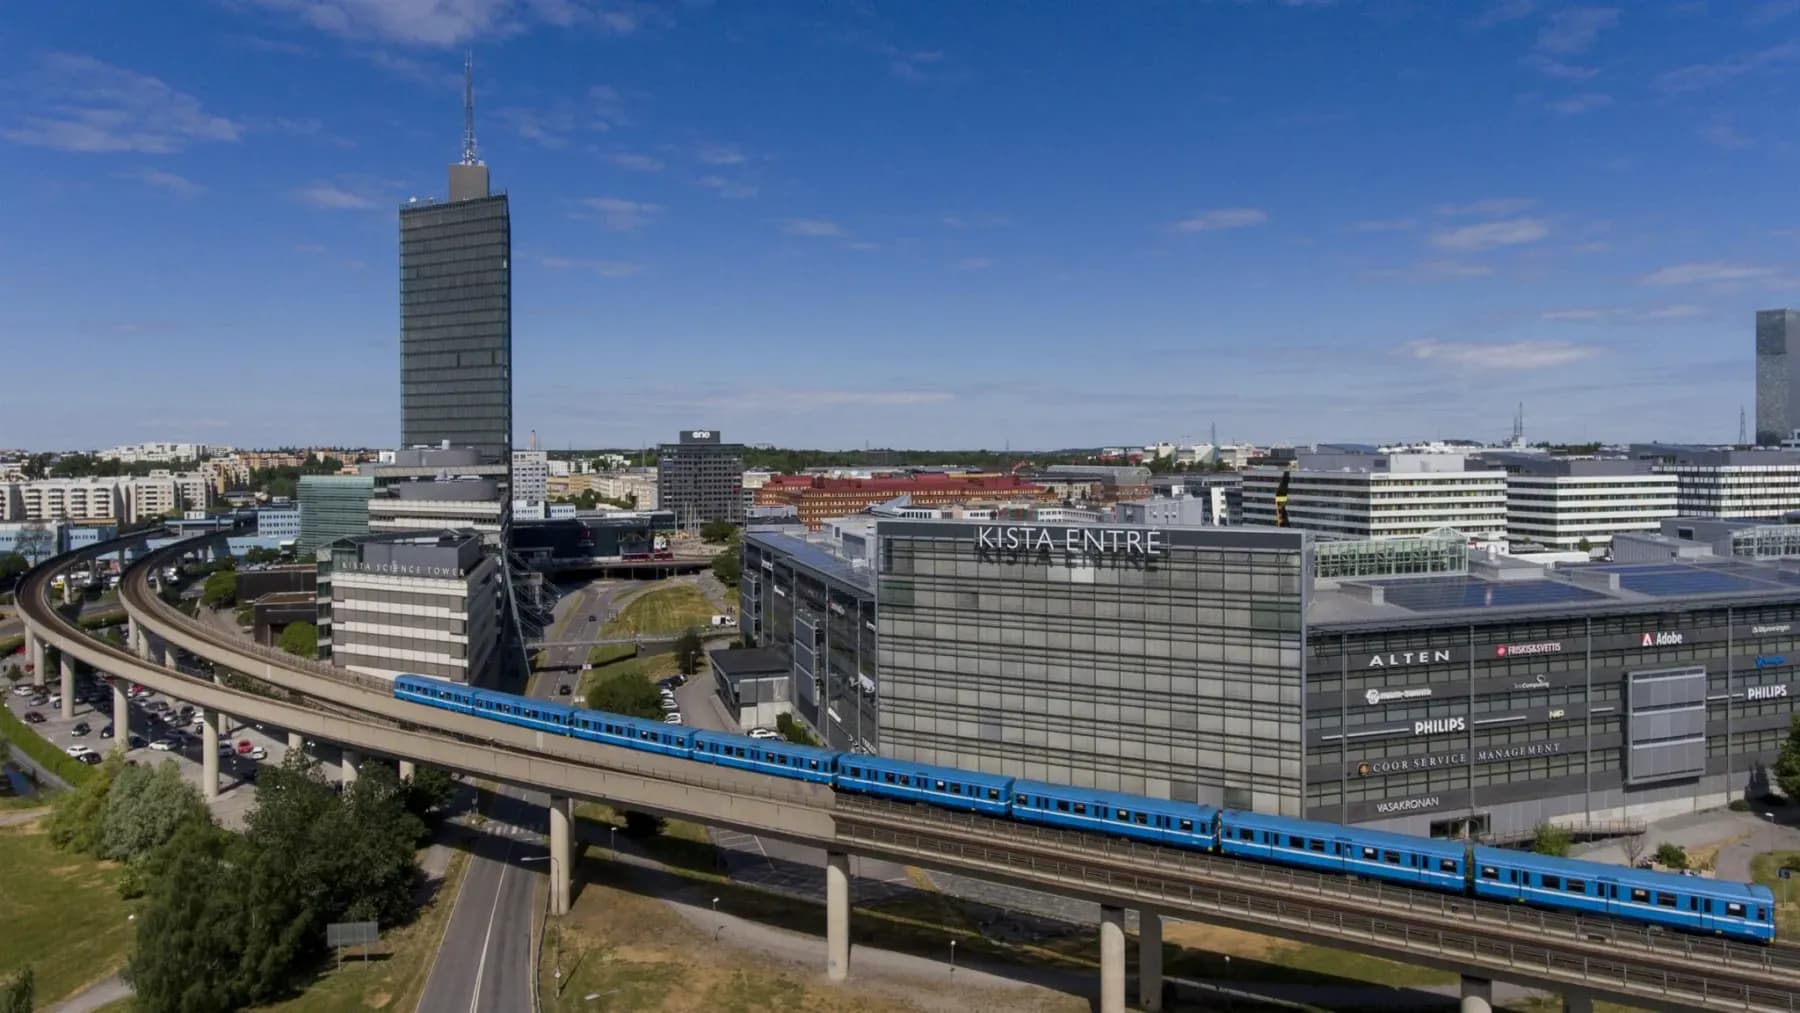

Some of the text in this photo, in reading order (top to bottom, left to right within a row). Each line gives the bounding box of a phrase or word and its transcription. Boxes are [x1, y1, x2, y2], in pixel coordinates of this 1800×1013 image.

[979, 526, 1161, 554] KISTA ENTRÉ
[376, 562, 421, 574] SCIENCE
[427, 566, 465, 577] TOWER
[1656, 631, 1682, 645] Adobe
[1369, 650, 1449, 667] ALTEN
[1748, 684, 1787, 700] PHILIPS
[1415, 717, 1465, 735] PHILIPS
[1373, 743, 1561, 773] COOR SERVICE MANAGEMENT
[1376, 797, 1439, 813] VASAKRONAN
